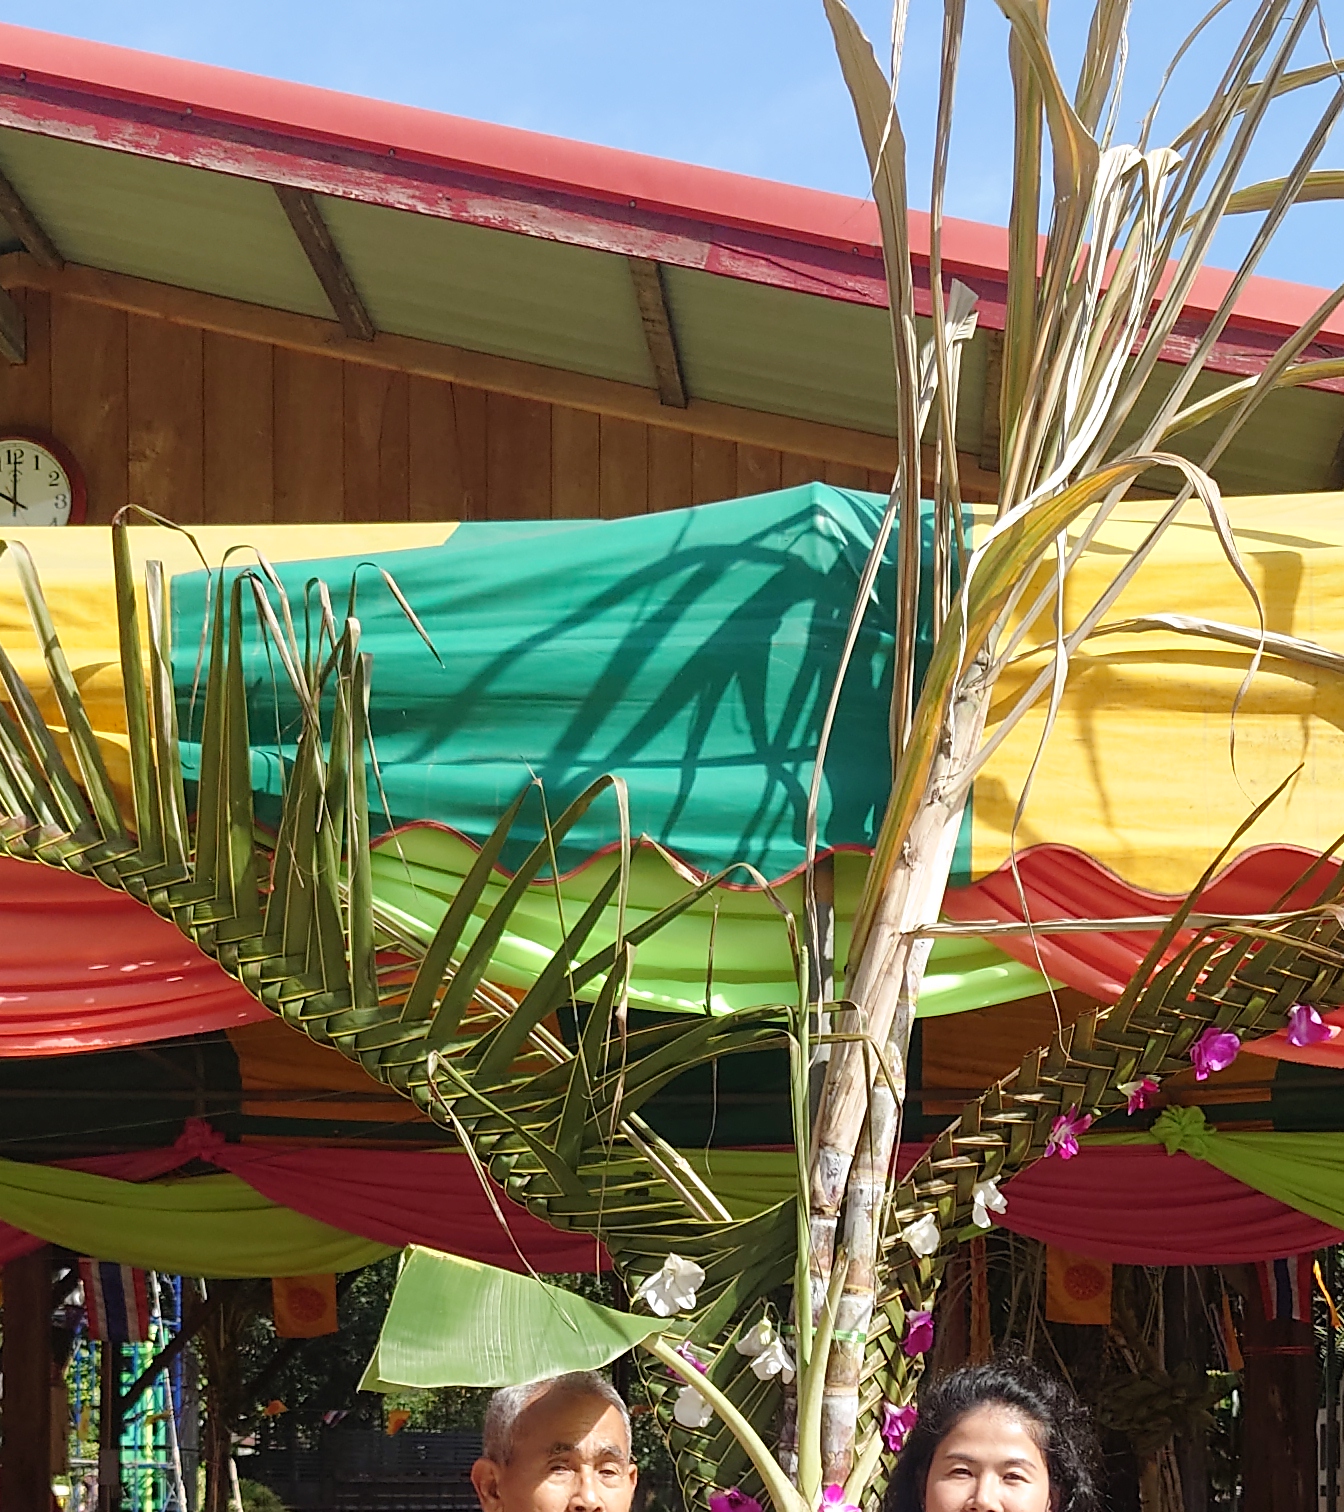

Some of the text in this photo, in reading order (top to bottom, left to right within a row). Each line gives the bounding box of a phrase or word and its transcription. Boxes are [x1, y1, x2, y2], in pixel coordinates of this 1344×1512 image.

[7, 449, 24, 465] 12
[34, 455, 40, 470] 1
[49, 471, 60, 486] 2
[55, 494, 67, 509] 3
